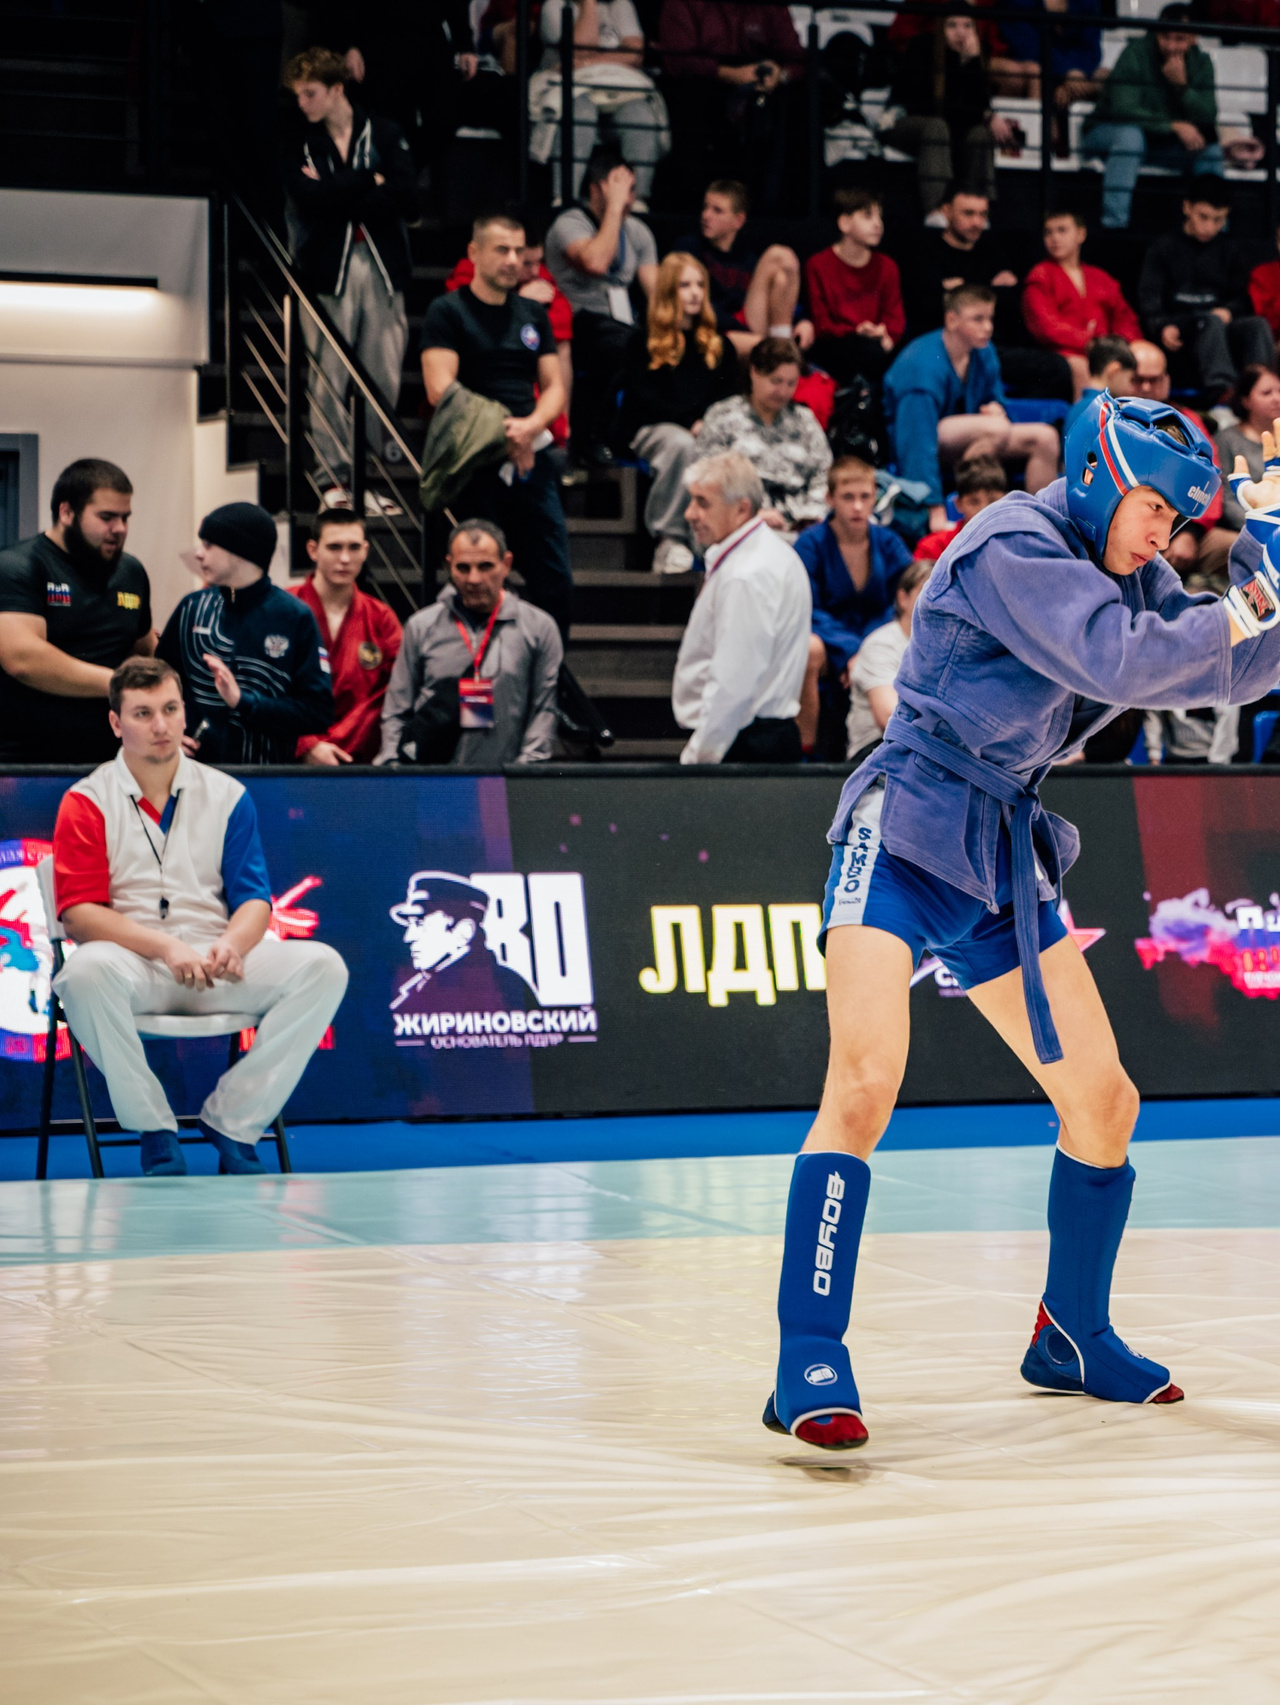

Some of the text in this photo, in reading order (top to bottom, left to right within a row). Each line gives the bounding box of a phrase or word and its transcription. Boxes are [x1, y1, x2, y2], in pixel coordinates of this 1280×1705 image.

[843, 826, 873, 894] SAMBO
[638, 903, 828, 1008] ЛДП
[393, 1005, 598, 1037] ЖИРИНОВСКИЙ
